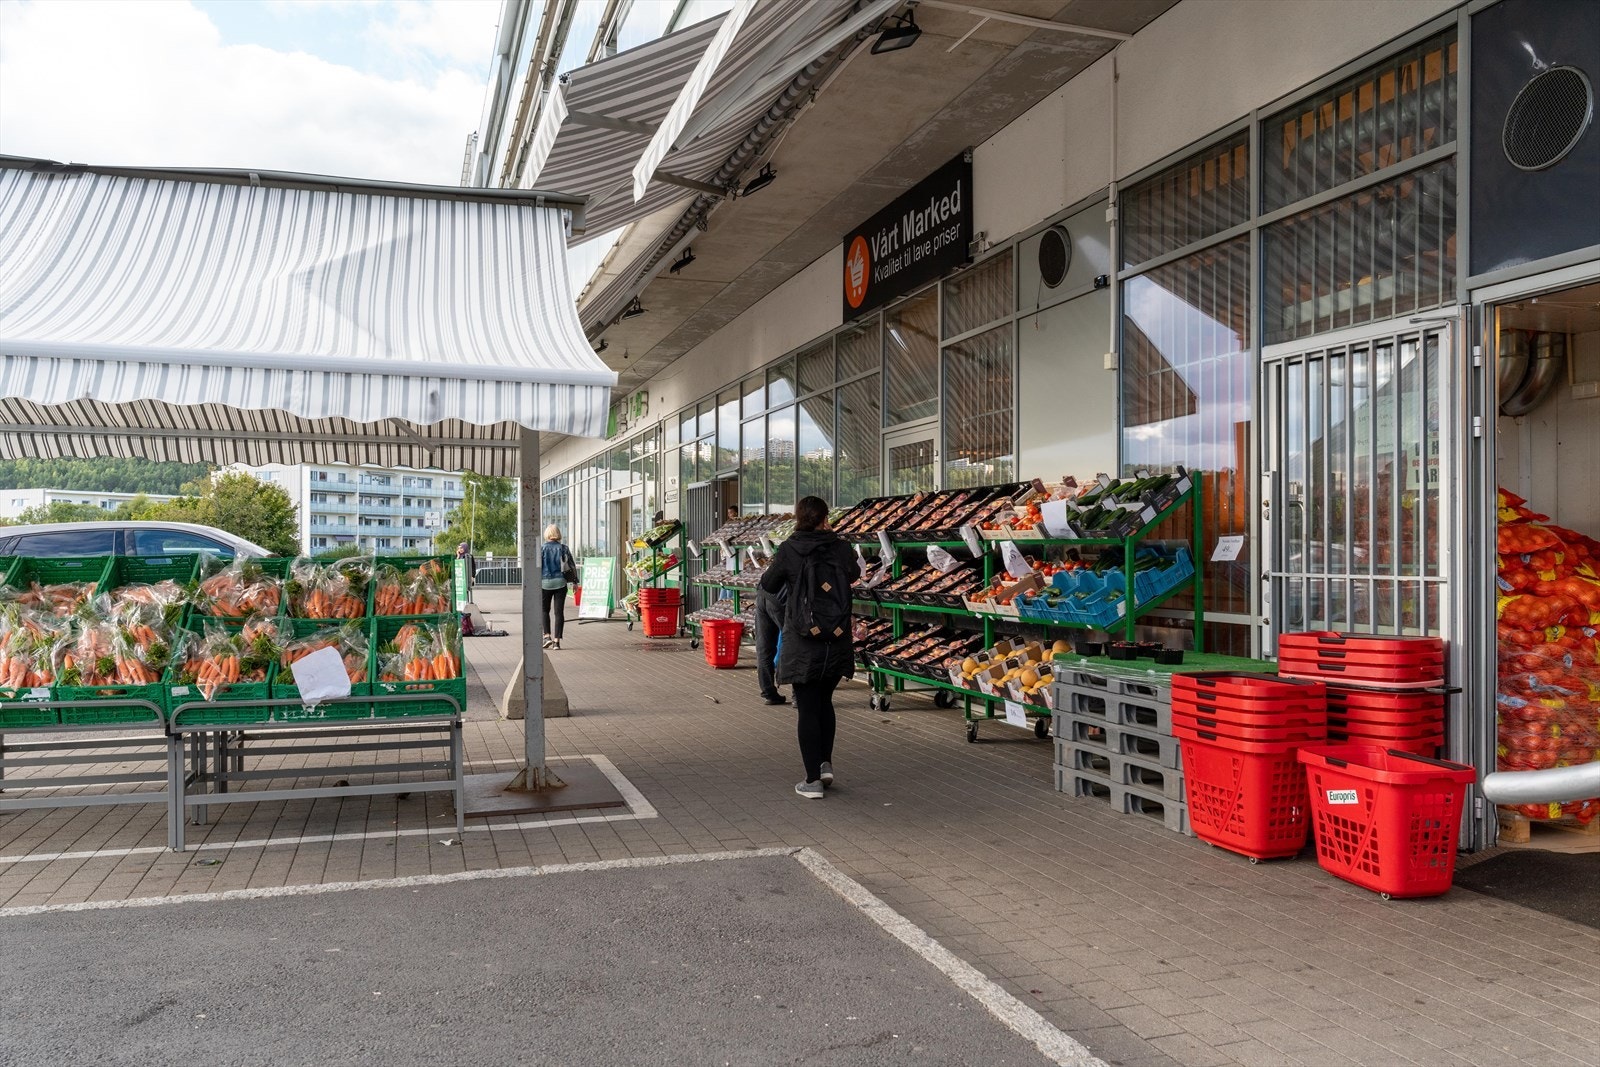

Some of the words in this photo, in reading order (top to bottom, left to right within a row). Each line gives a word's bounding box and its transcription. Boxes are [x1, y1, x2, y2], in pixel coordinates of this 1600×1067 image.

[871, 222, 899, 262] Vårt
[902, 180, 961, 245] Marked
[874, 254, 903, 284] Kvalitet
[904, 248, 912, 266] til
[913, 240, 931, 261] lave
[933, 223, 961, 256] priser
[1329, 790, 1356, 803] Europris
